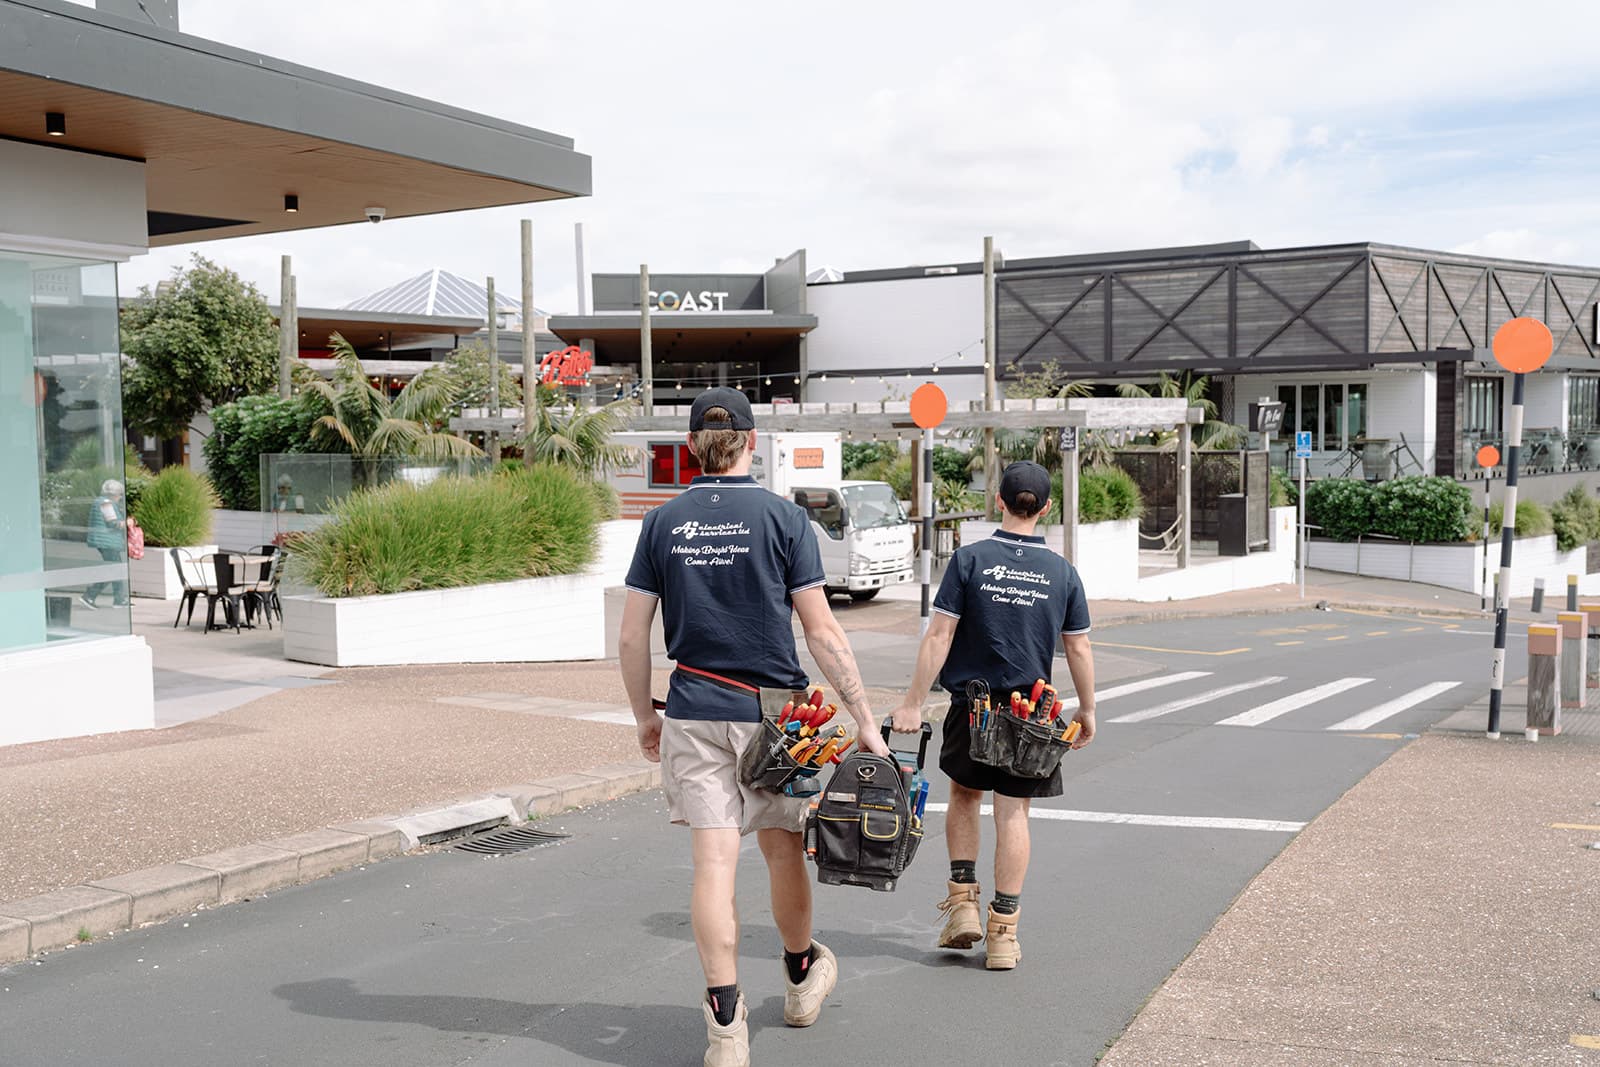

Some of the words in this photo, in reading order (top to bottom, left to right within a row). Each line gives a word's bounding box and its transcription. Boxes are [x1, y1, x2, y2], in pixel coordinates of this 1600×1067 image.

[671, 545, 701, 555] Making
[701, 545, 728, 555] Bright
[685, 557, 707, 565] Come
